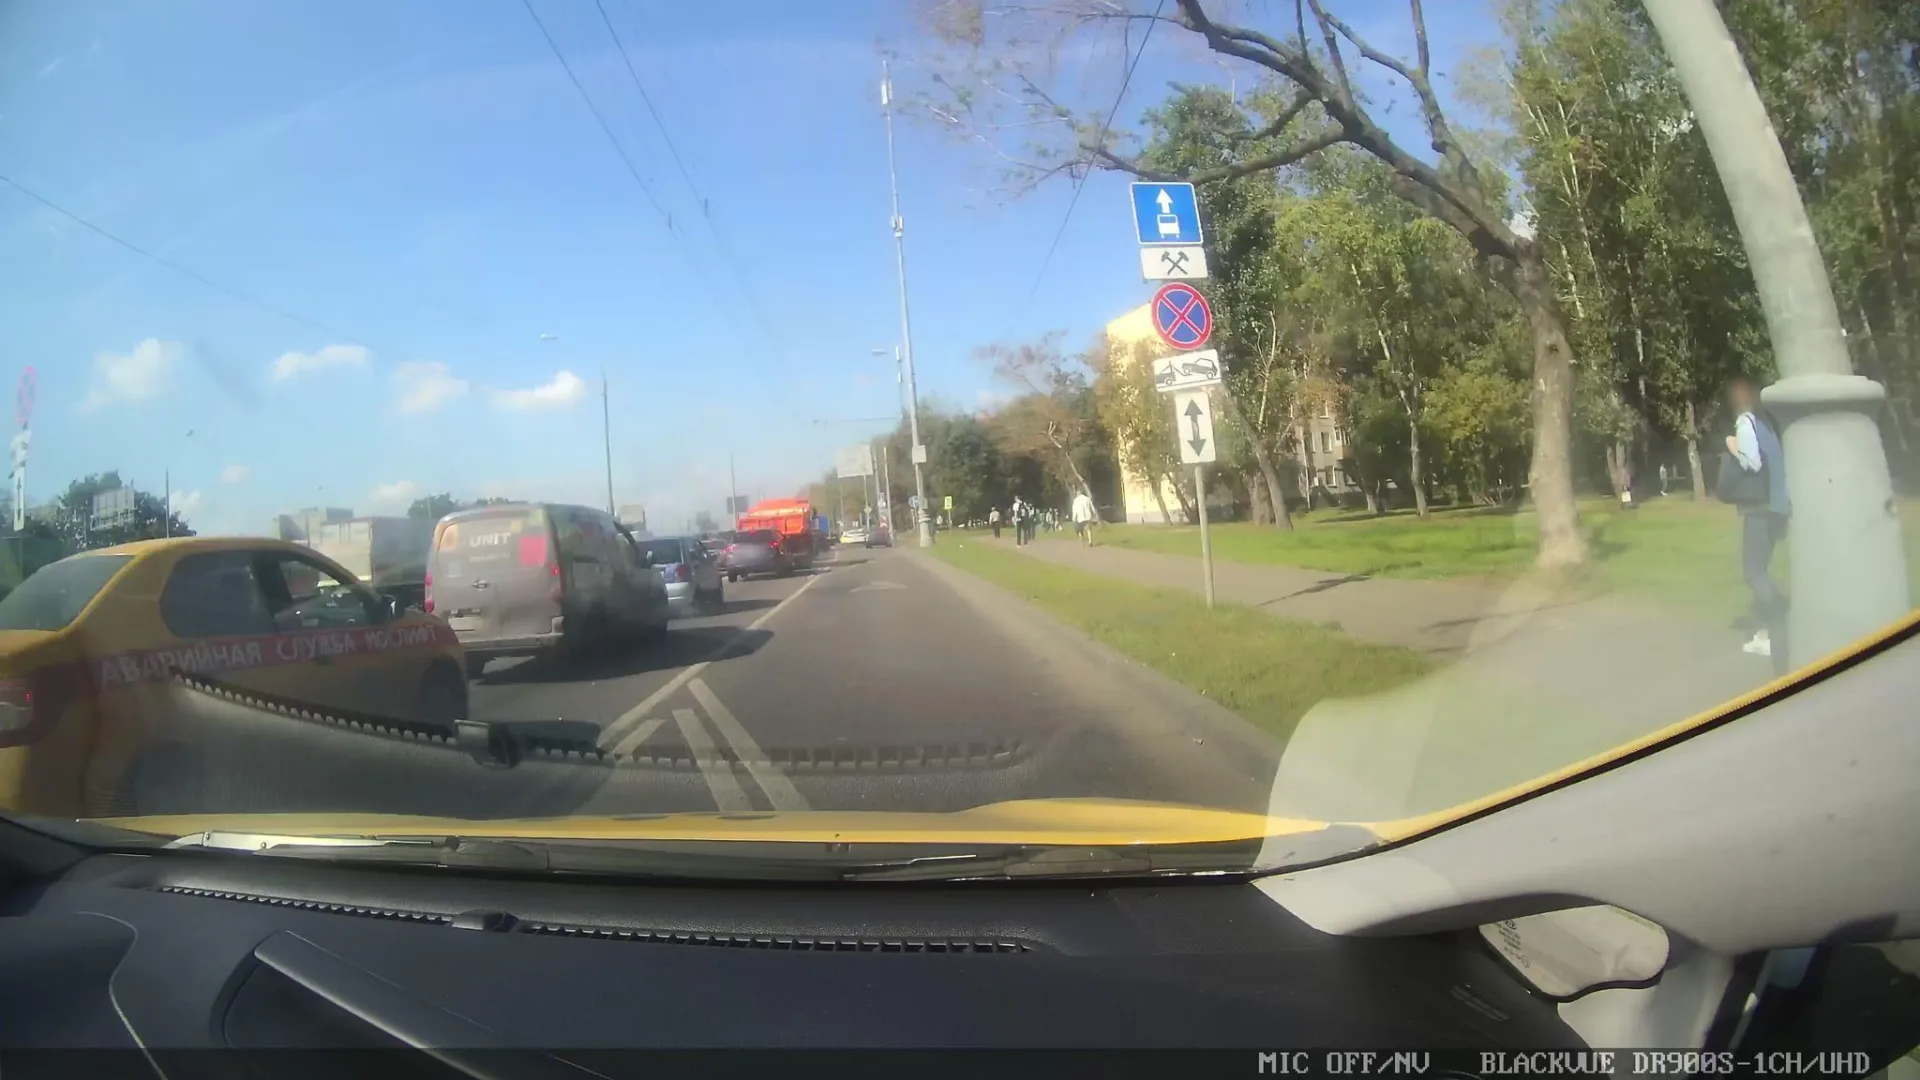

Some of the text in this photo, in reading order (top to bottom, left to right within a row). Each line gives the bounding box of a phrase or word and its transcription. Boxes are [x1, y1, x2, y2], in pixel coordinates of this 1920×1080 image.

[469, 531, 511, 548] UNIT
[101, 640, 263, 688] АВАРИЙНАЯ
[276, 632, 357, 661] СЛУЖБА
